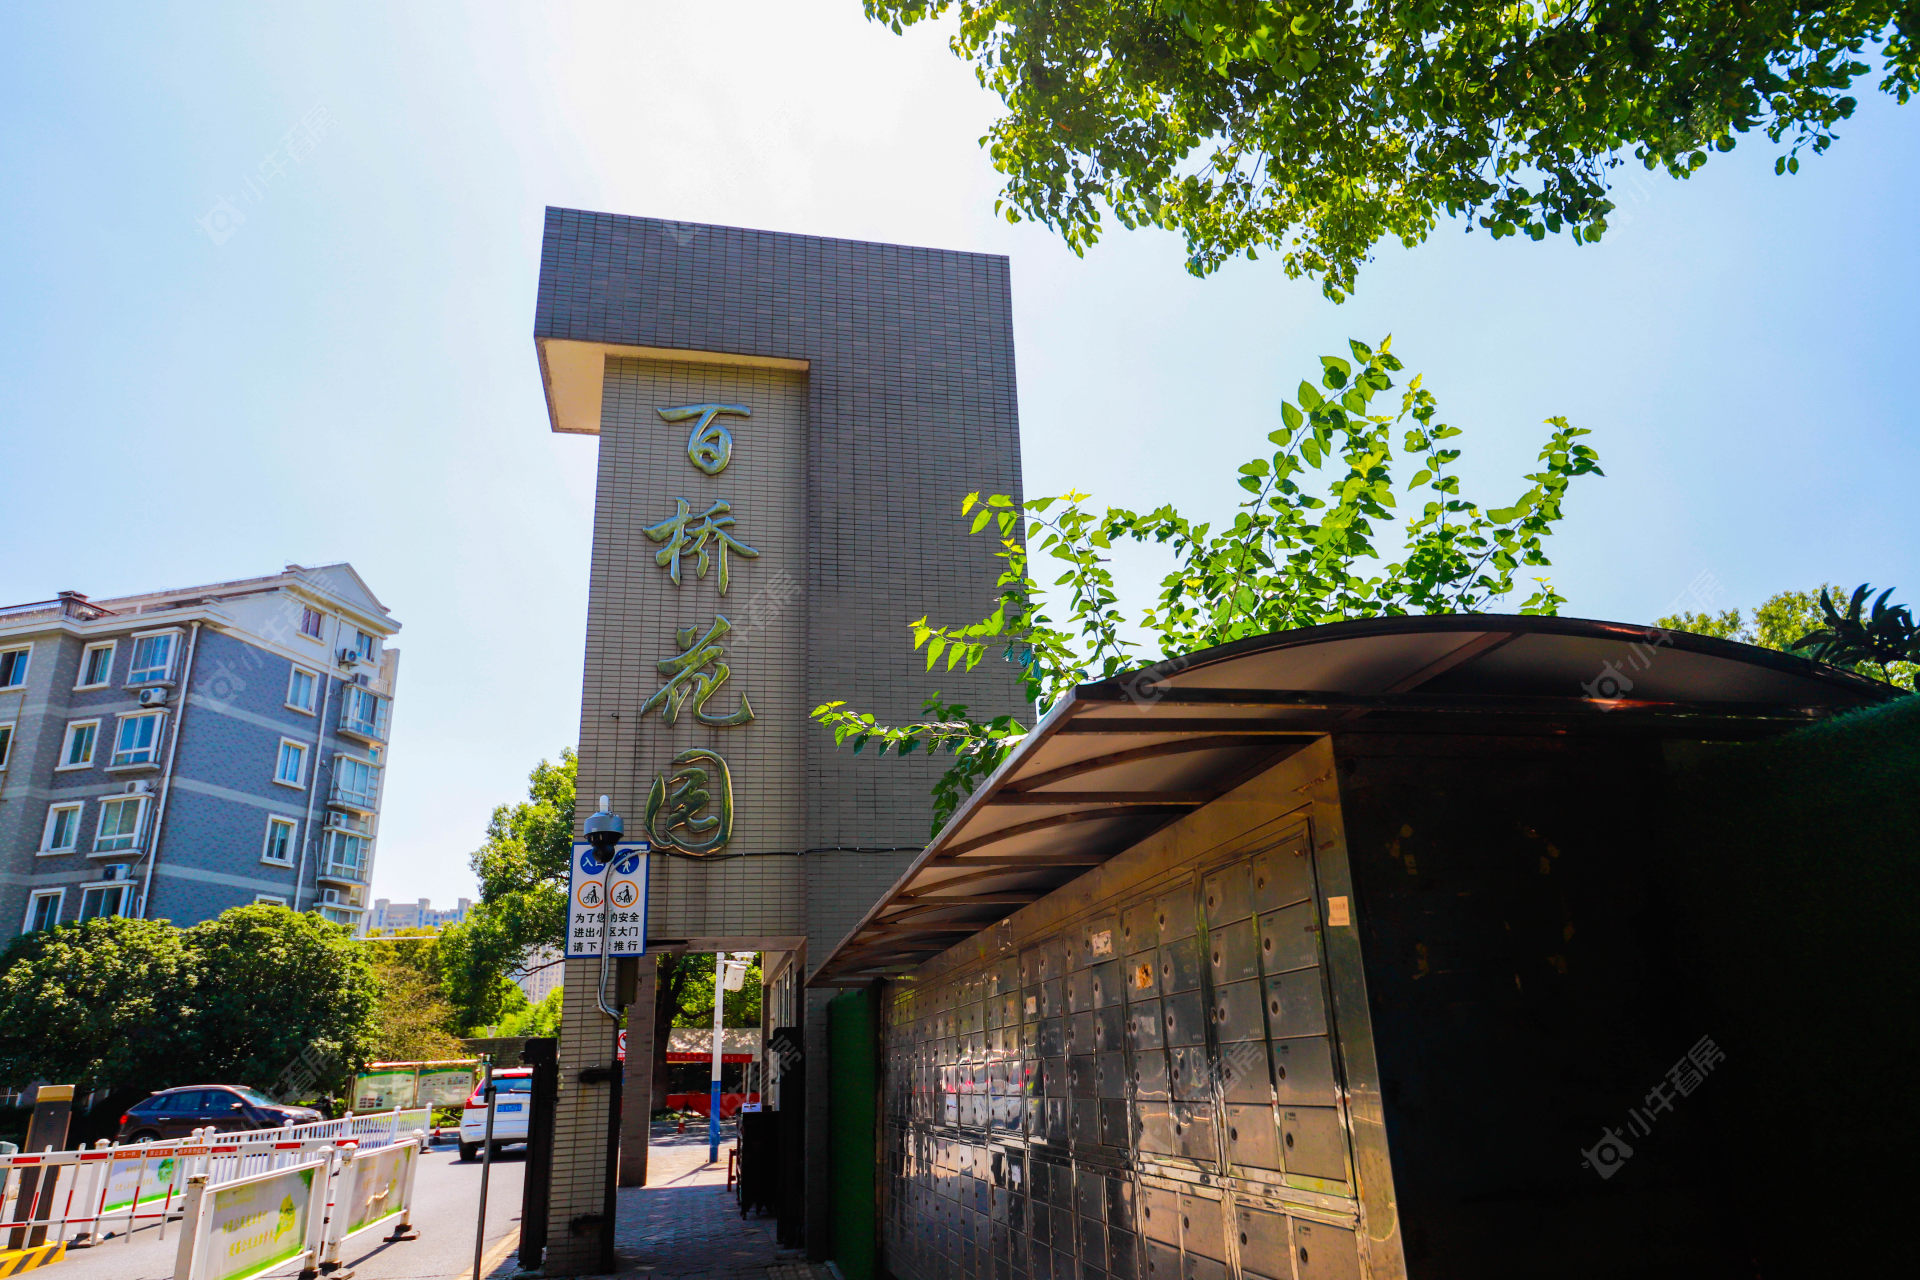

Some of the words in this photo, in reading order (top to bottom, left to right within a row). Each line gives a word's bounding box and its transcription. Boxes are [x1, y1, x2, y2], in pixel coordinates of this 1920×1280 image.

[641, 403, 760, 858] 百桥花园
[573, 940, 638, 953] 请下推行
